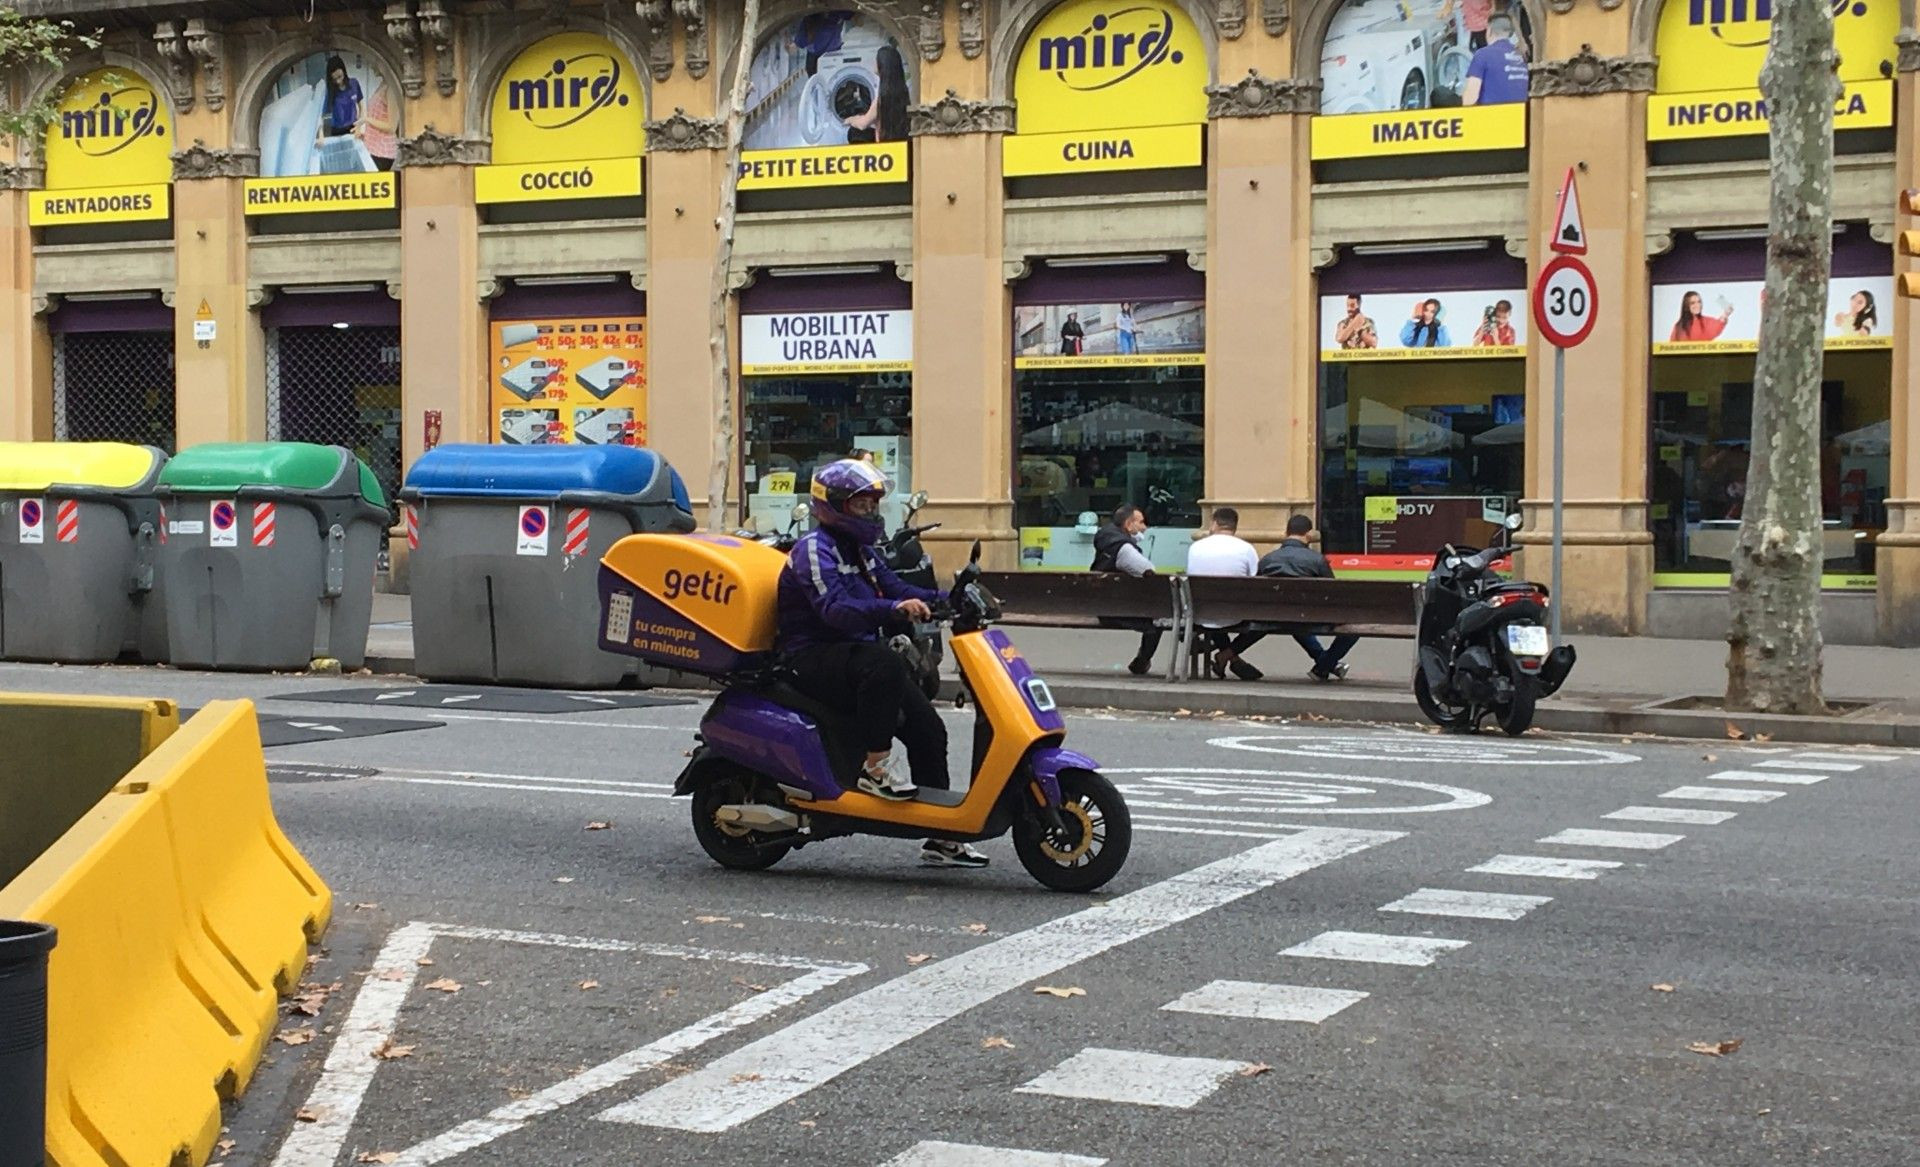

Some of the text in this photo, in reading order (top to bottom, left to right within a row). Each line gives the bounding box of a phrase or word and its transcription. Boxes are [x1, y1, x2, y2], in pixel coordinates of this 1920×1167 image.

[1373, 118, 1463, 143] IMATGE
[1063, 139, 1134, 161] CUINA
[740, 154, 893, 178] PETIT ELECTRO
[521, 167, 593, 190] COCCIÓ
[44, 194, 152, 215] RENTADORES
[248, 181, 390, 205] RENTAVAIXELLES
[1550, 287, 1586, 317] 30
[770, 313, 890, 338] MOBILITAT
[783, 338, 877, 361] URBANA
[663, 569, 737, 605] getir
[635, 619, 696, 641] tu compra
[633, 638, 700, 659] en minutos
